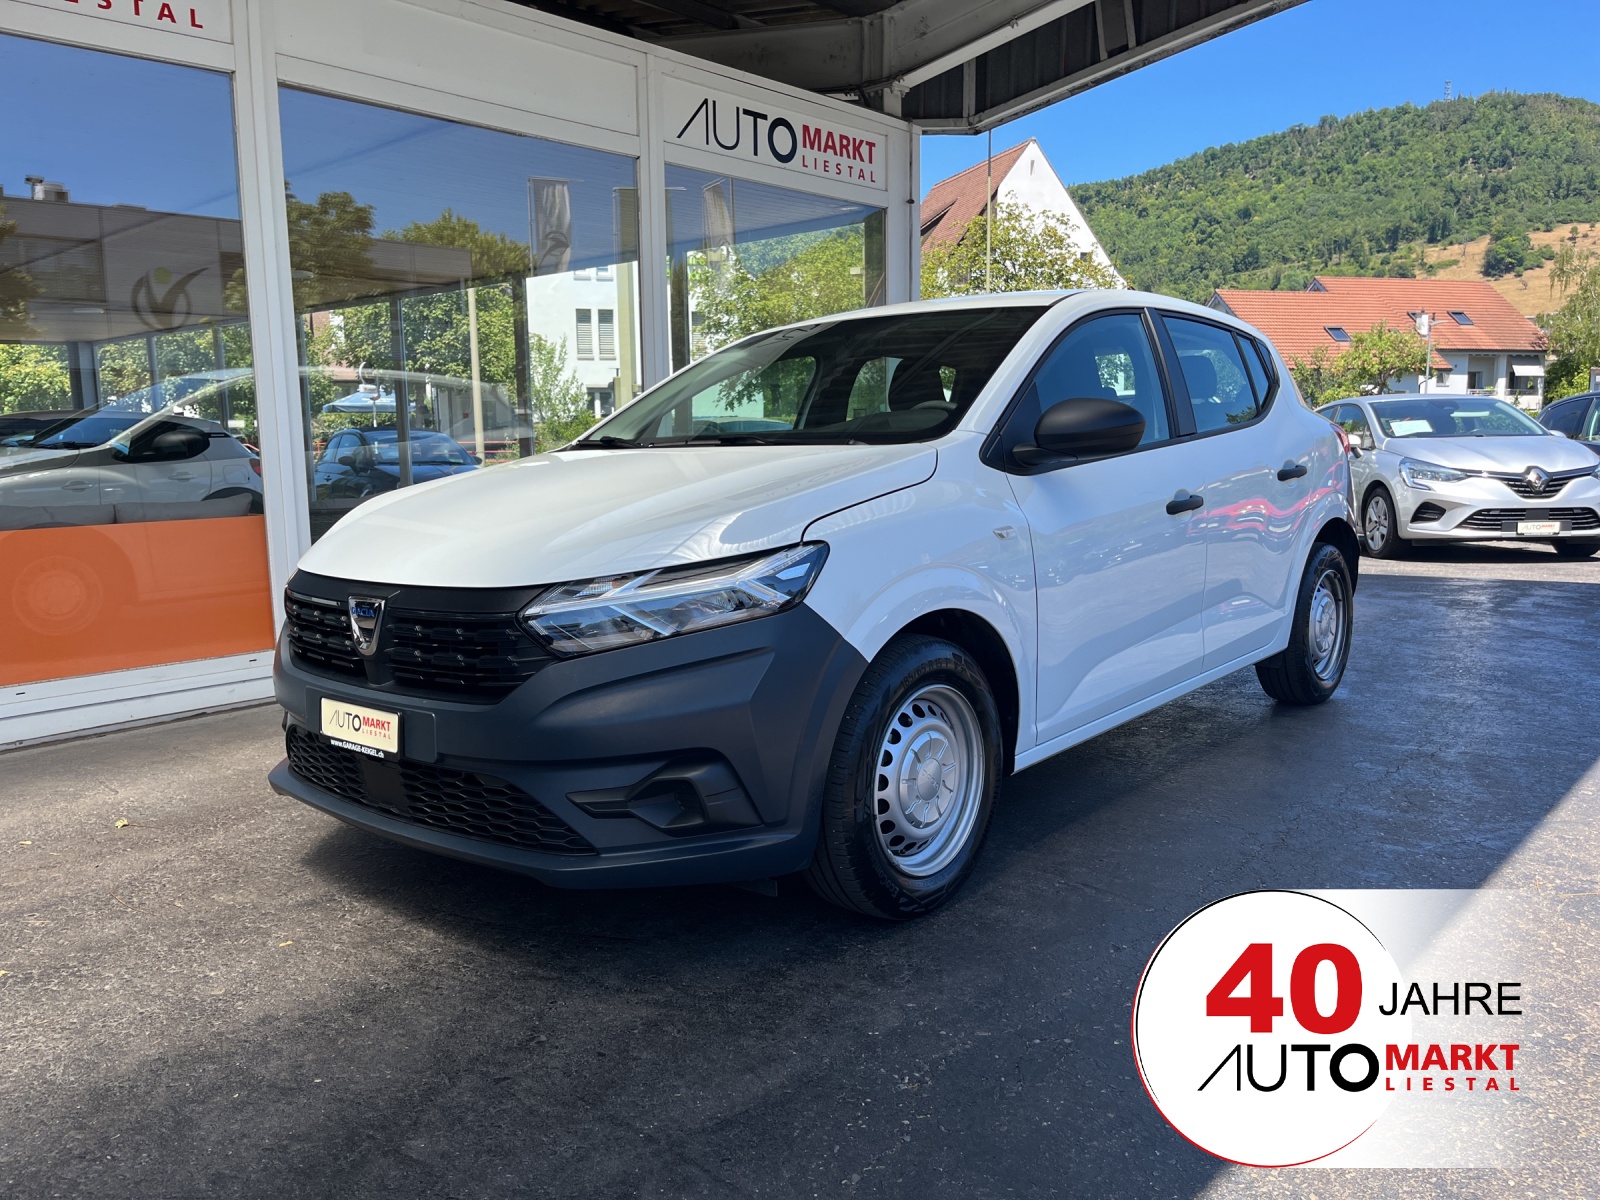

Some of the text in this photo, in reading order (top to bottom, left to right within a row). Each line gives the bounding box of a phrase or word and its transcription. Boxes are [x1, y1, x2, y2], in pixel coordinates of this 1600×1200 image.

[64, 0, 203, 29] STAL
[802, 154, 876, 183] LIESTAL
[361, 728, 391, 740] LIESTAL
